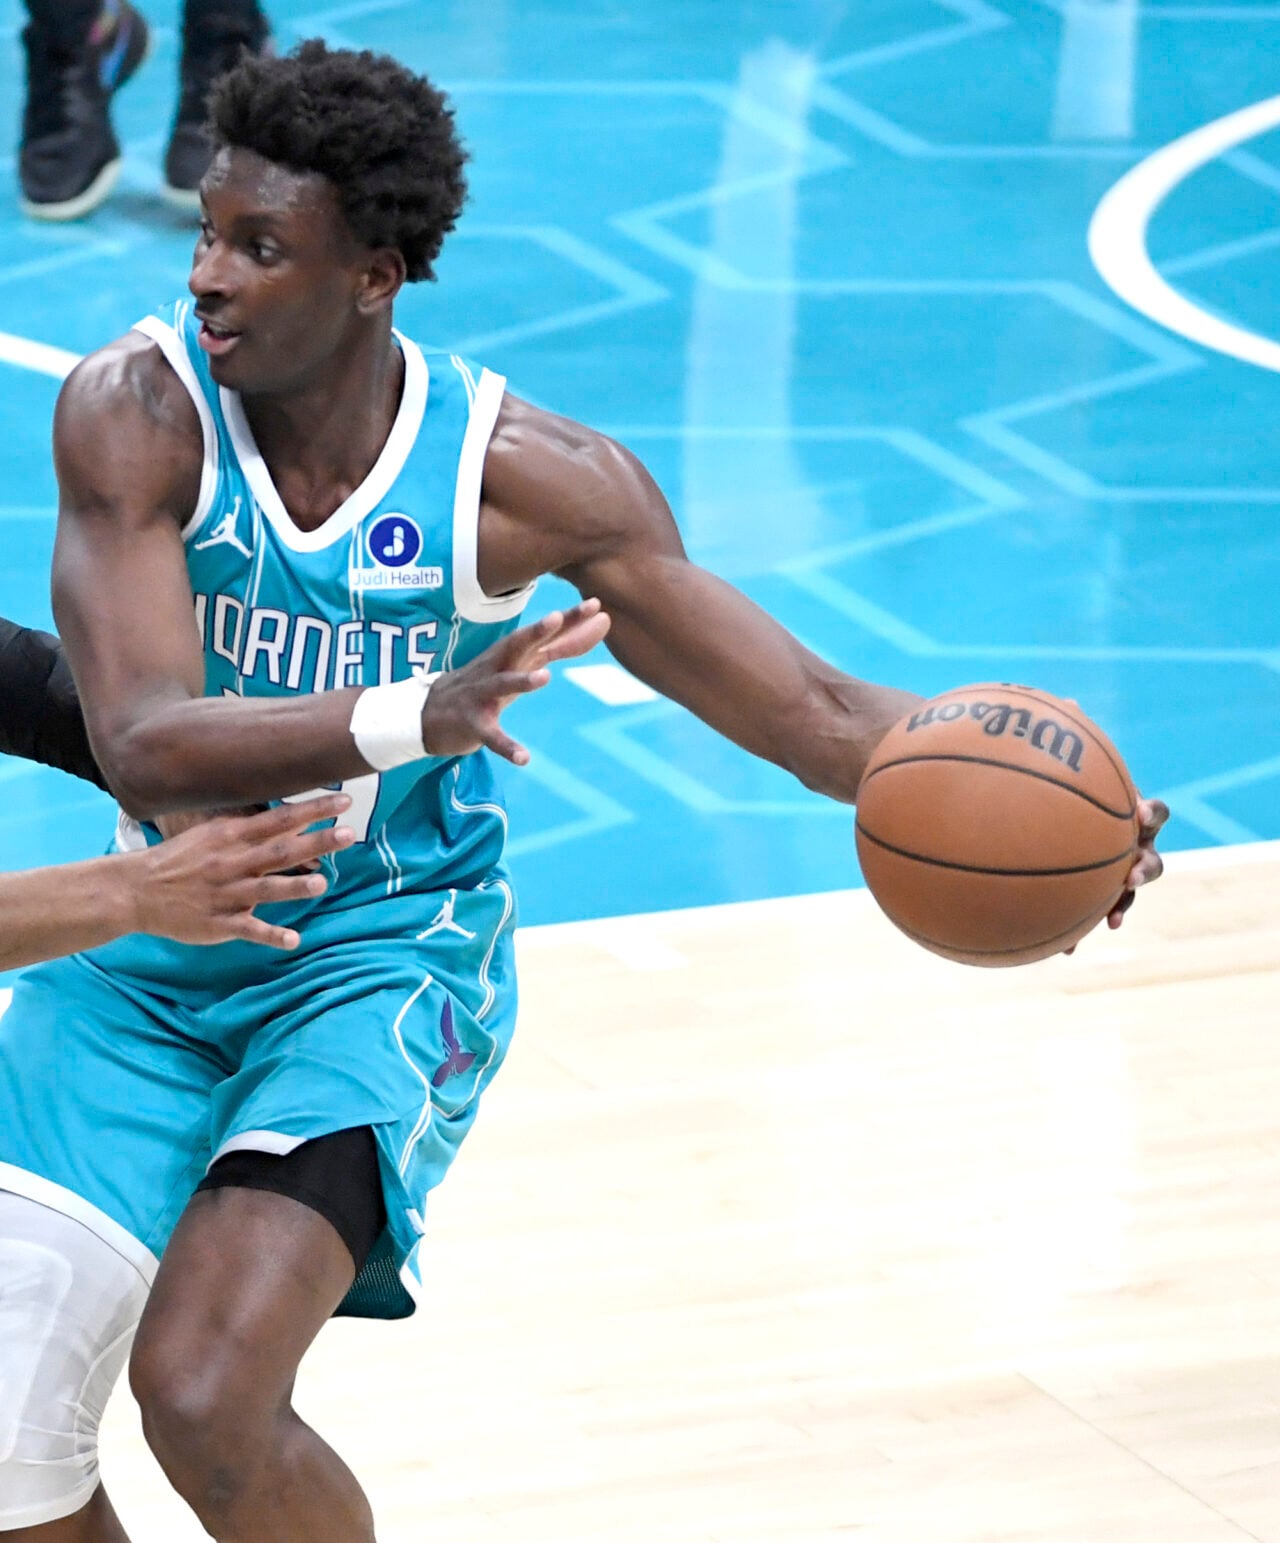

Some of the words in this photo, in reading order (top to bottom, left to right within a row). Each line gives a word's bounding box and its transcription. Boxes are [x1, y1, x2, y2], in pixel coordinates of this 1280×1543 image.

[353, 571, 388, 586] Judi
[391, 569, 439, 585] Health
[906, 701, 1084, 773] Wilson
